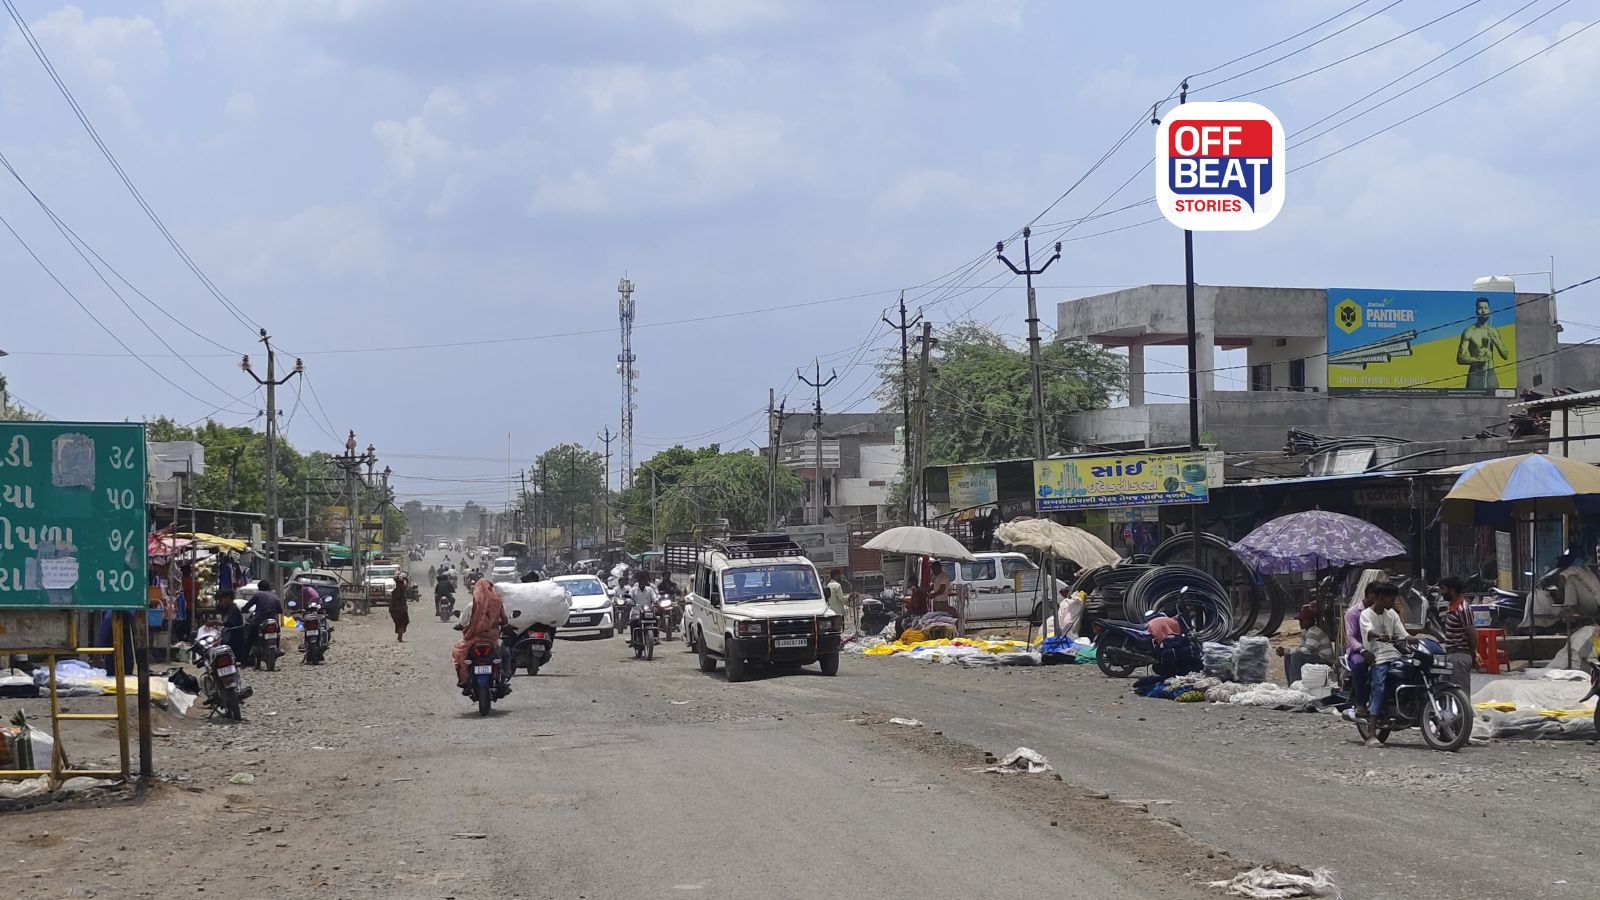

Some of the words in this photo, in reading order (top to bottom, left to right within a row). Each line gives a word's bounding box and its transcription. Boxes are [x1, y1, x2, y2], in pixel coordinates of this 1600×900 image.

[1366, 308, 1415, 322] PANTHER
[0, 434, 33, 468] ડી
[0, 484, 35, 509] યા
[106, 488, 135, 510] ૫૦
[96, 569, 135, 592] ૧૨૦
